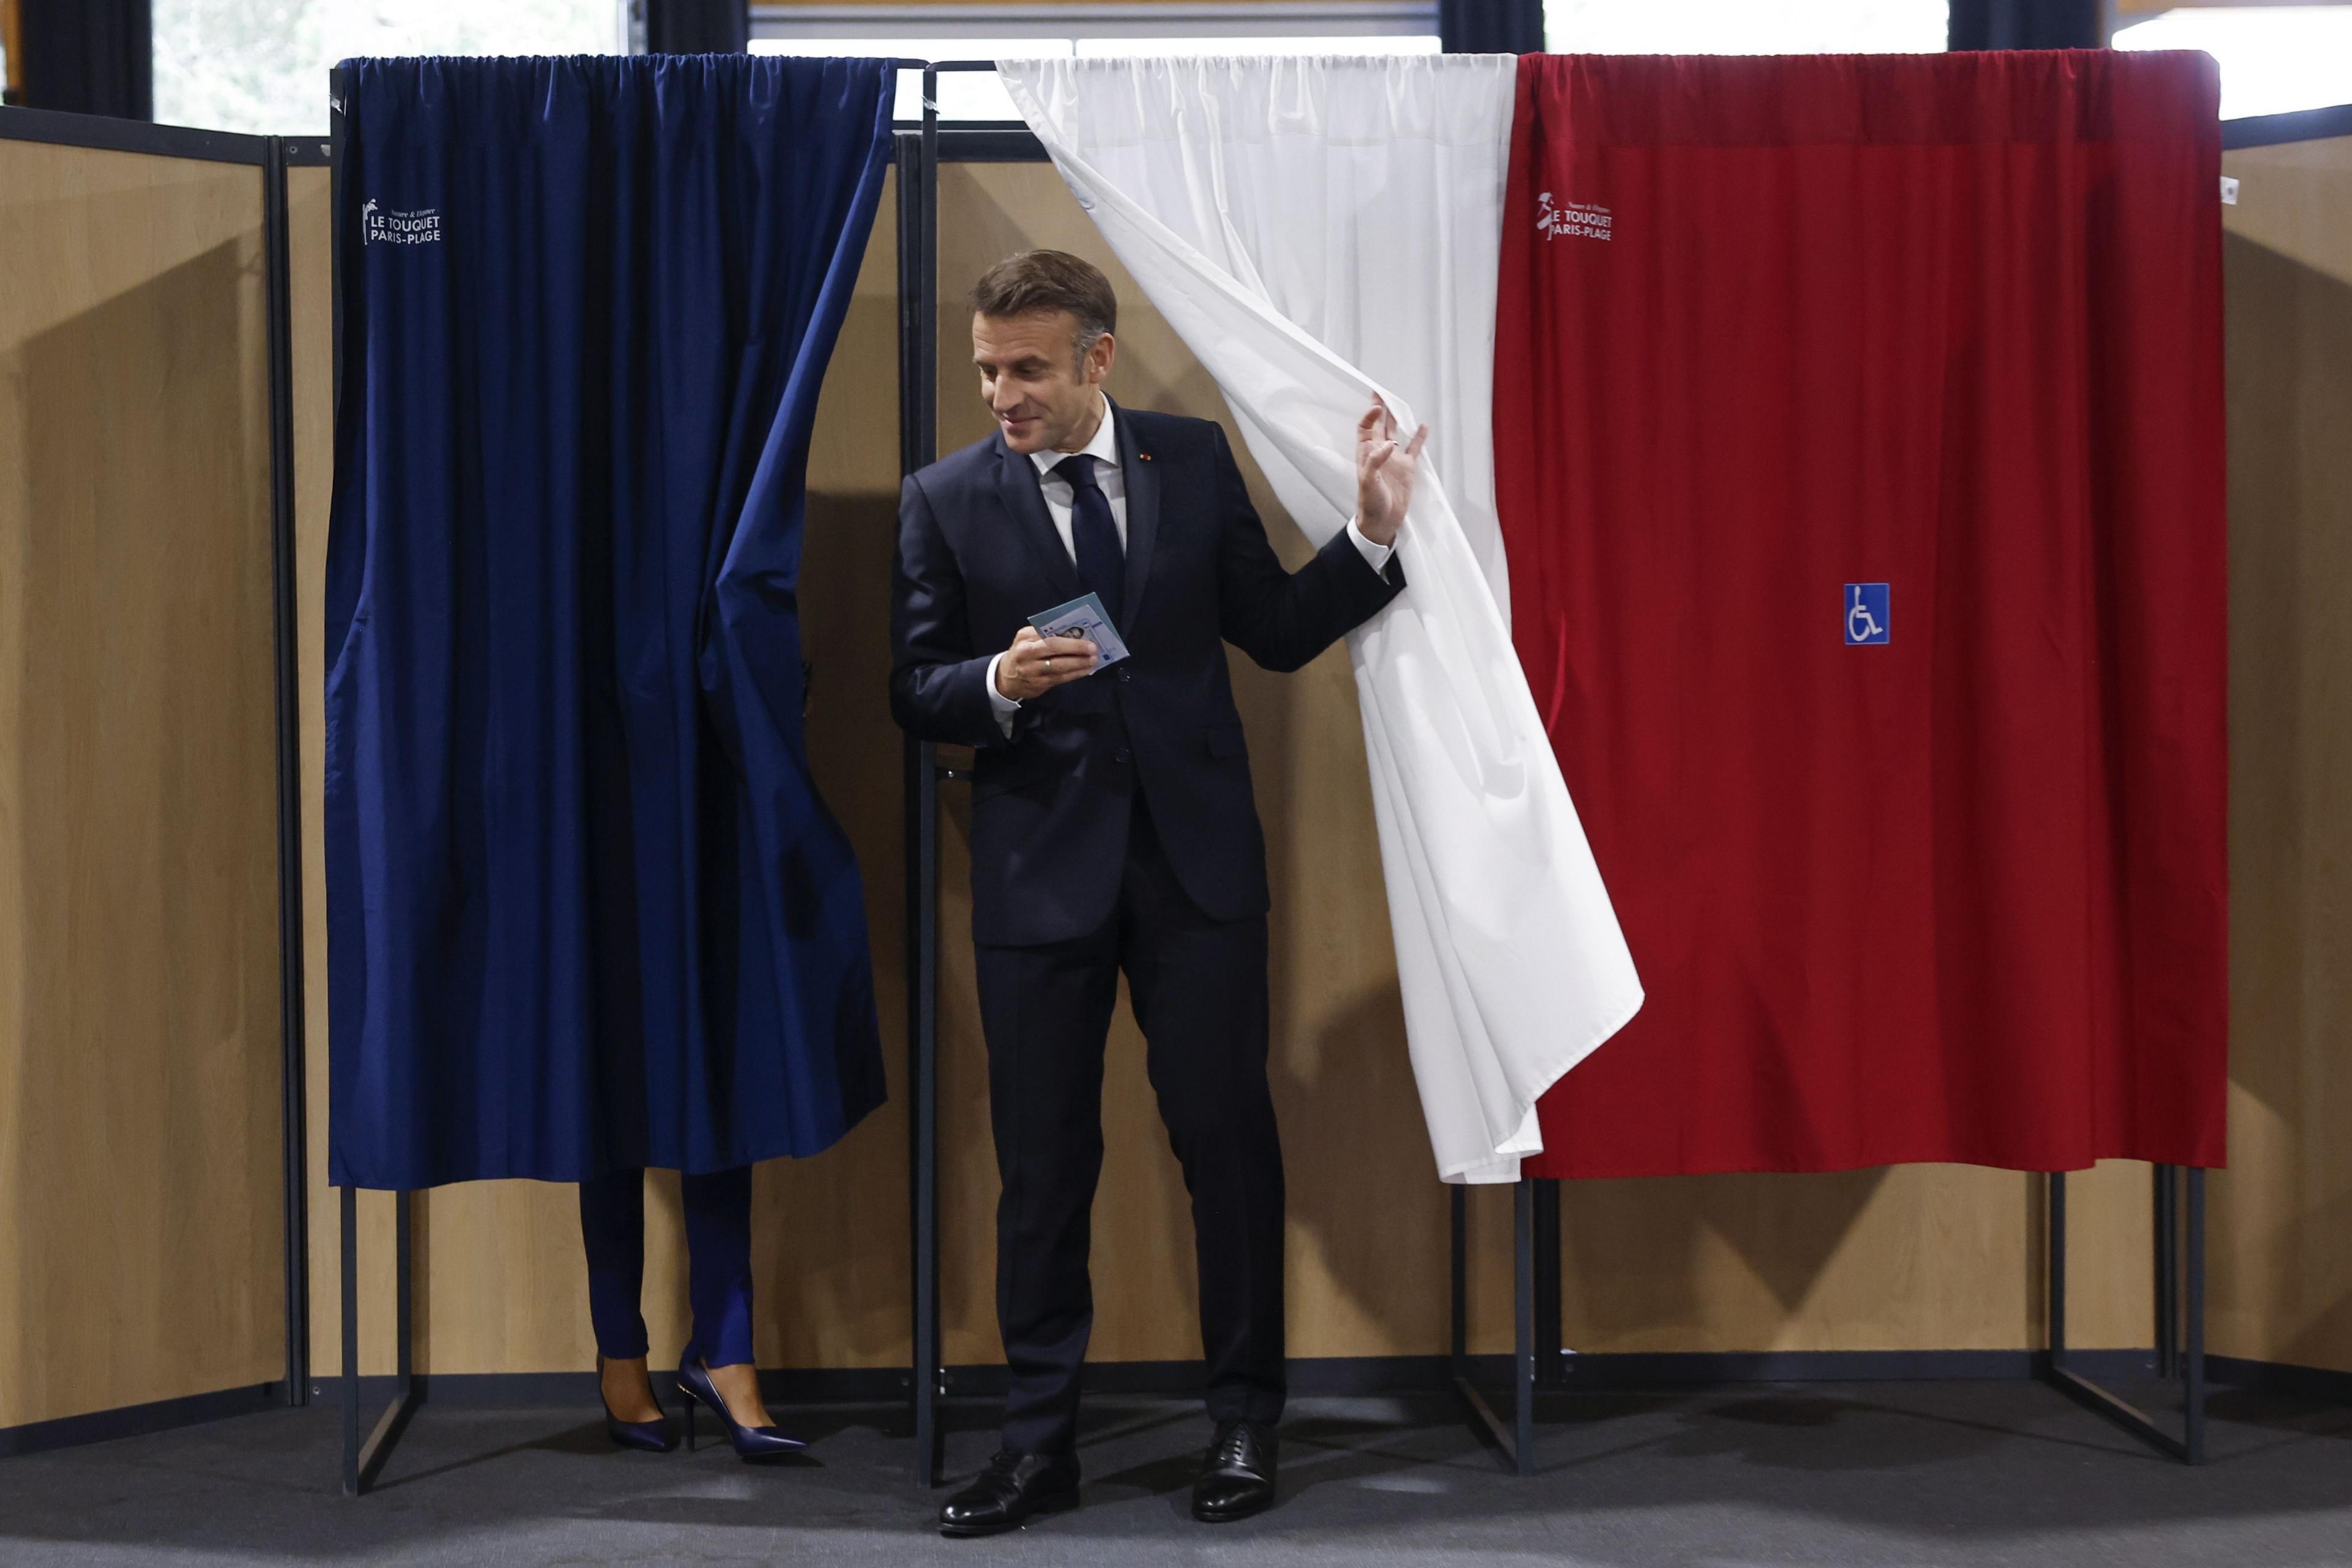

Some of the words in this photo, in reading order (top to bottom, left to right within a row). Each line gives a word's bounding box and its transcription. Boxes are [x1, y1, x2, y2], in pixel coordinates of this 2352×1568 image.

[371, 216, 385, 227] LE
[388, 216, 440, 232] TOUQUET
[1564, 210, 1612, 227] TOUQUET
[371, 230, 440, 244] PARIS-PLAGE
[1550, 224, 1611, 241] PARIS-PLAGE
